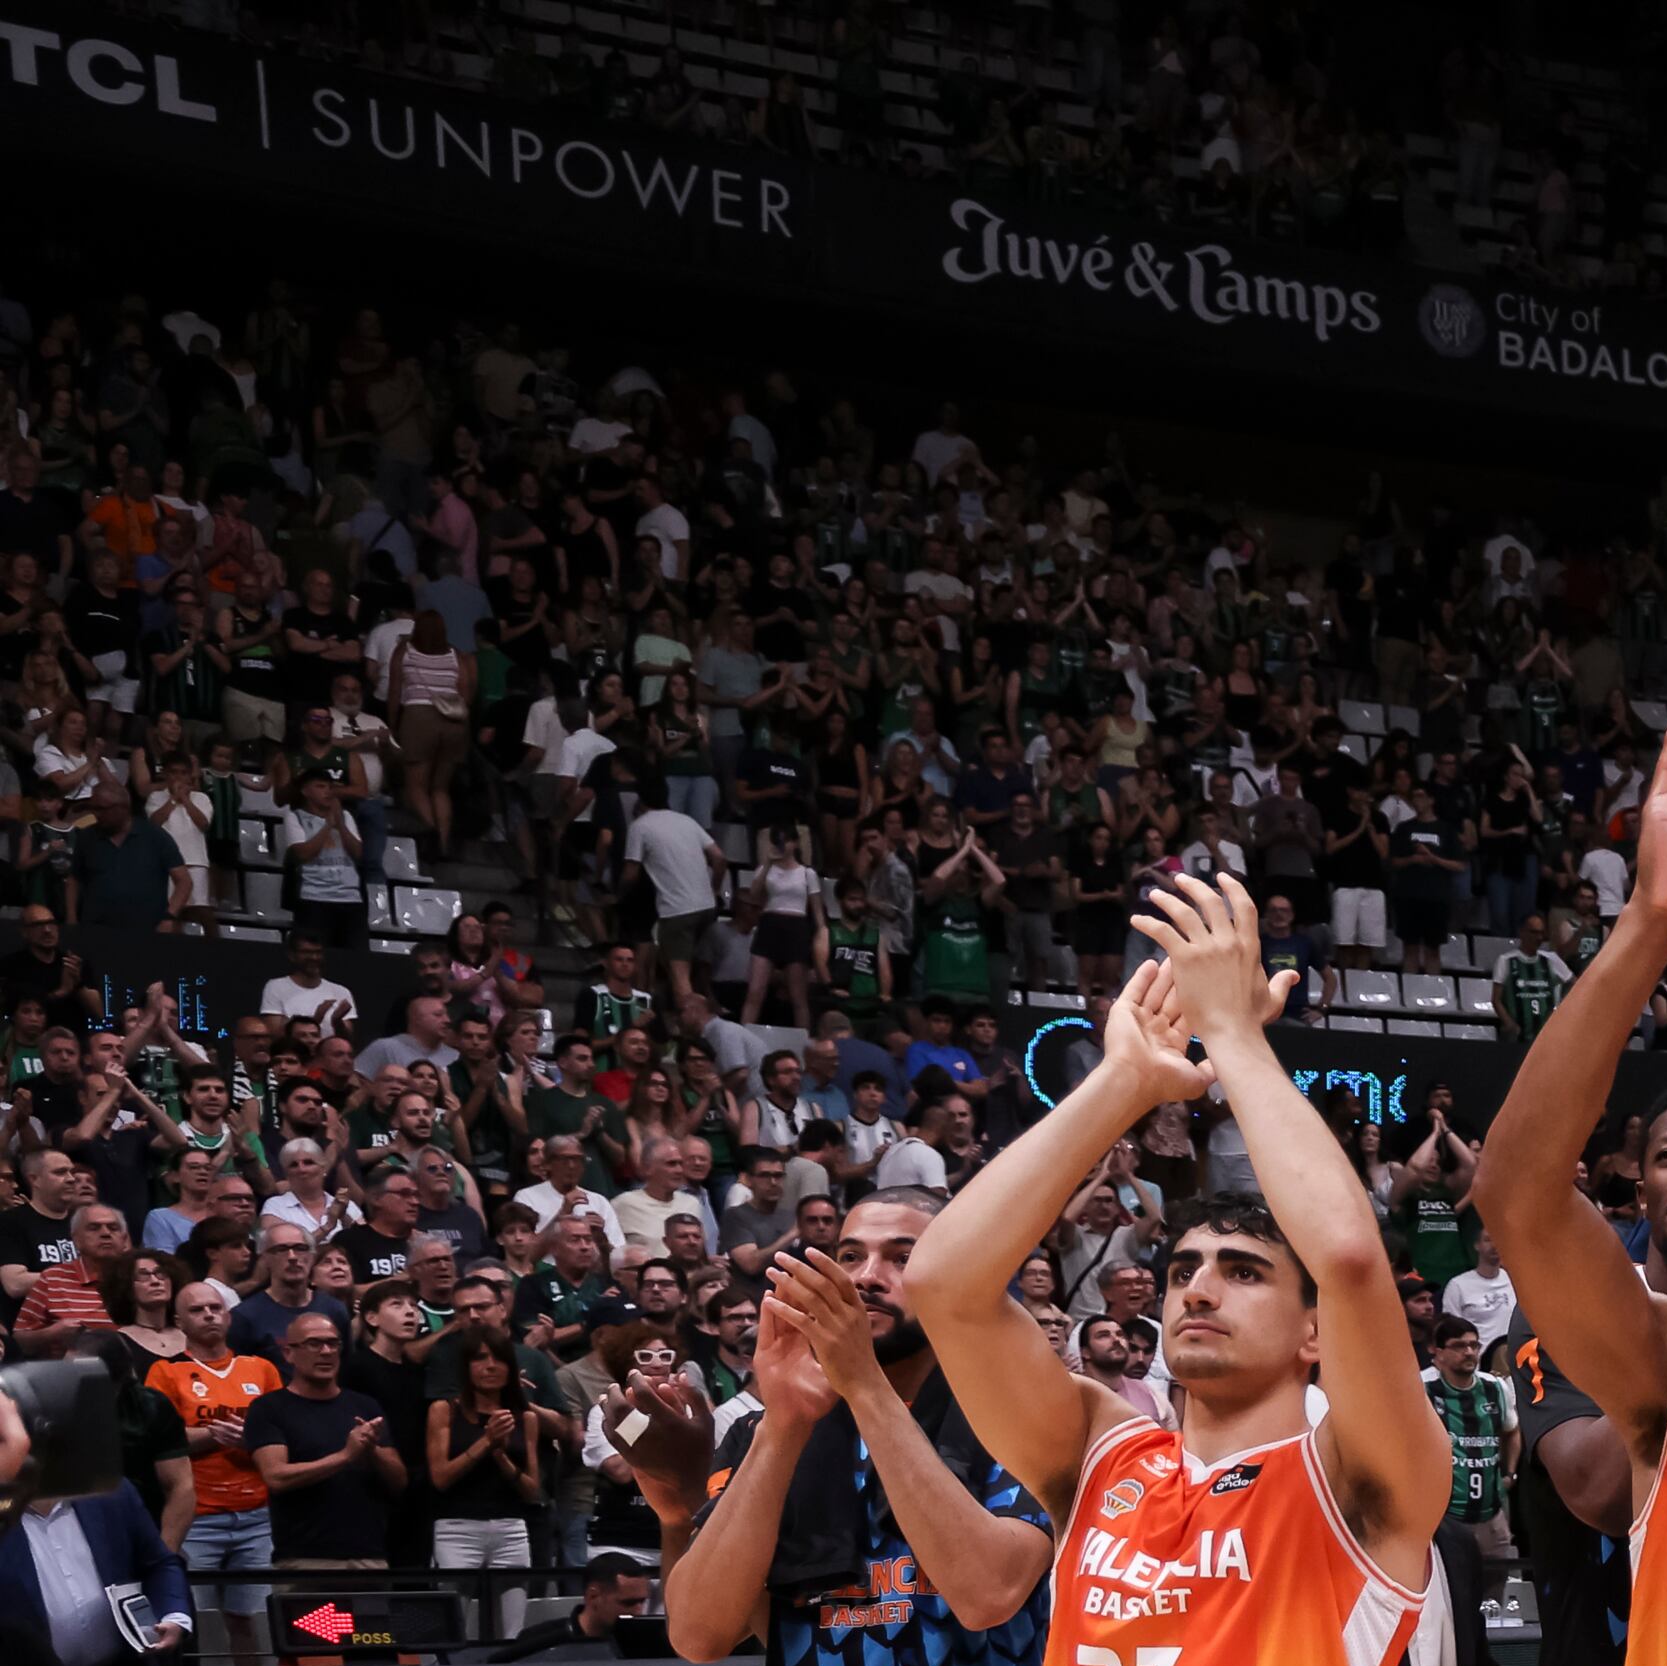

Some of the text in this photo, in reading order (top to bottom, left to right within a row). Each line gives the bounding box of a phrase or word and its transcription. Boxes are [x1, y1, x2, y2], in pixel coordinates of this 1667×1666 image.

[0, 21, 793, 238] TCL SUNPOWER
[943, 198, 1382, 343] Juvé & Camps
[1495, 292, 1602, 336] City of
[1469, 1473, 1483, 1500] 9
[819, 1600, 912, 1629] BASKET
